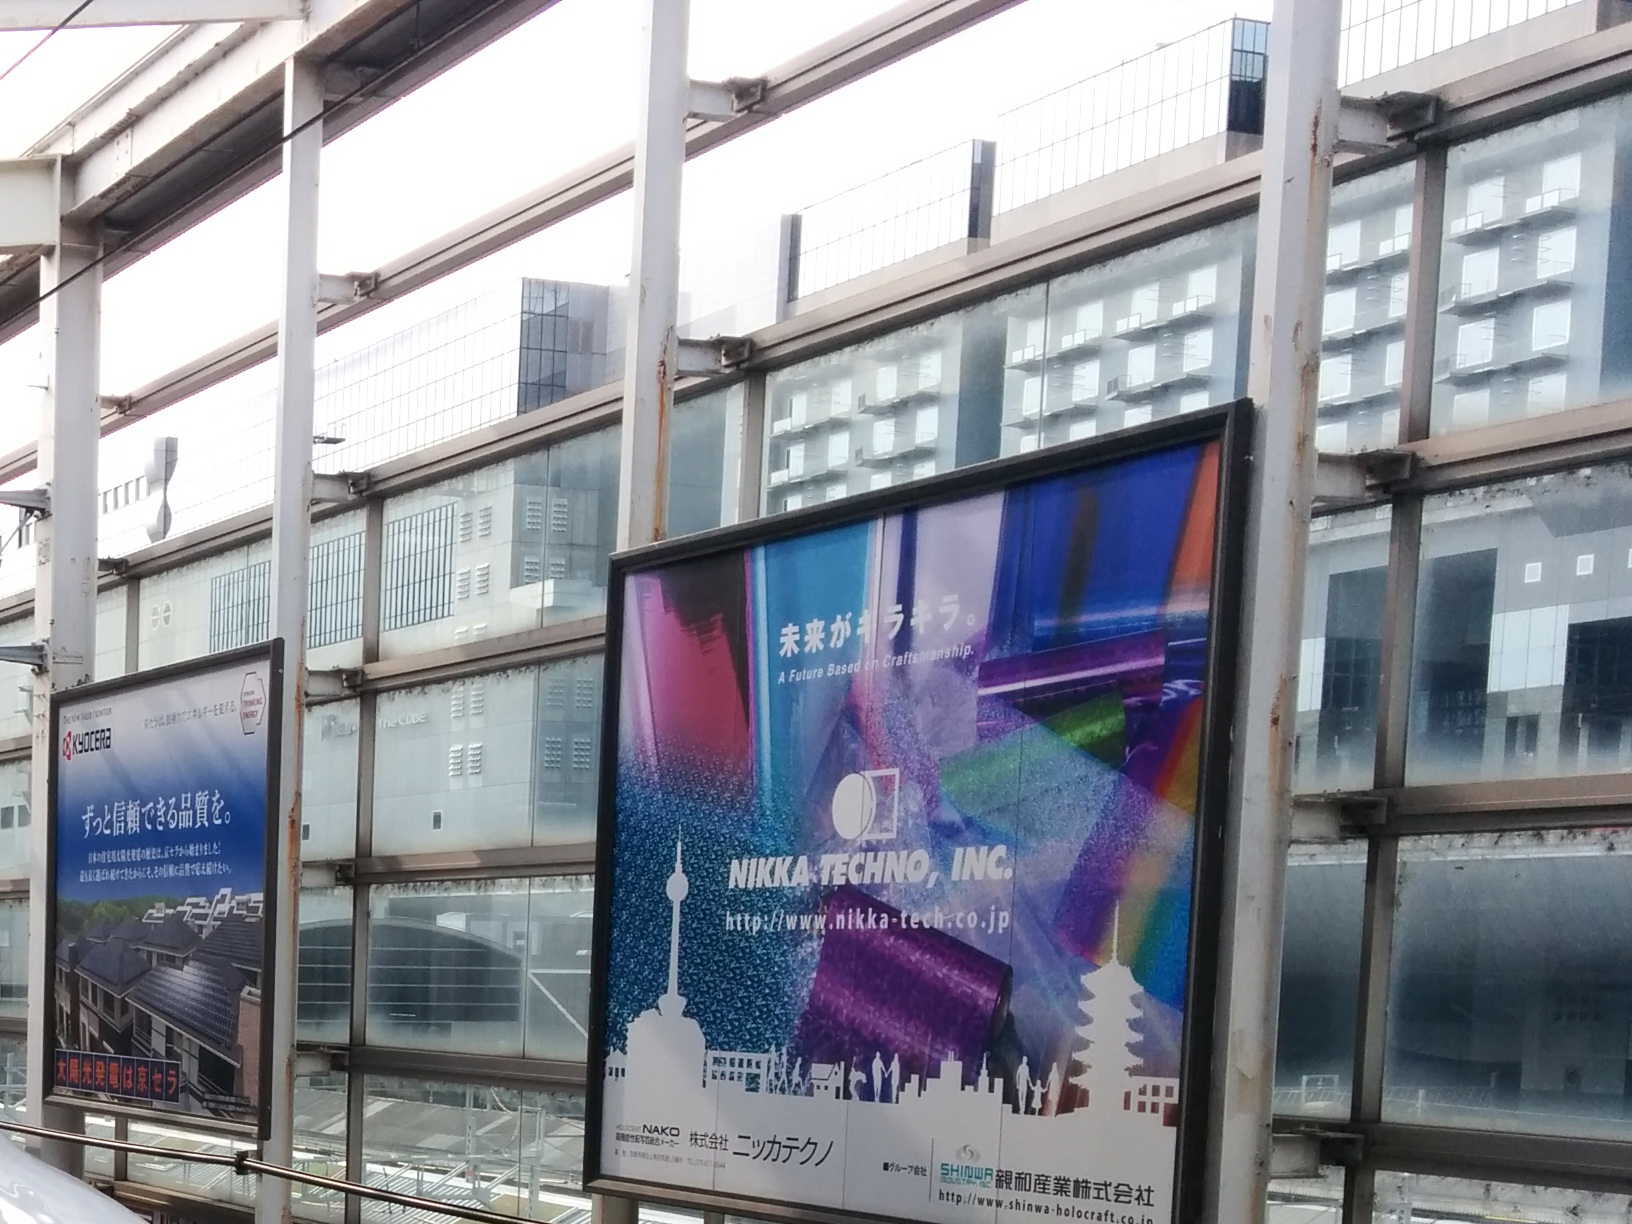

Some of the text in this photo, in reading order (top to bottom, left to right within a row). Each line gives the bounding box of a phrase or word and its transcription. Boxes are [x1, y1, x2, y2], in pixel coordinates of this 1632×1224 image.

[779, 595, 975, 657] 未来がキラキラ。
[778, 643, 974, 684] A Future Based on Craftsmanship.
[72, 727, 111, 755] KYOCERA
[81, 789, 231, 839] ずっと信頼できる品質を。
[728, 845, 1013, 889] NIKKA TECHNO, INC.
[725, 904, 1011, 935] http://www.nikka-tech.co.jp
[57, 1058, 178, 1095] 太陽光発電は京セラ
[642, 1124, 680, 1137] NAKO
[689, 1130, 729, 1152] 株式会社
[732, 1133, 834, 1167] ニッカテクノ
[940, 1162, 994, 1181] SHINWA
[994, 1168, 1156, 1208] 親和産業株式会社
